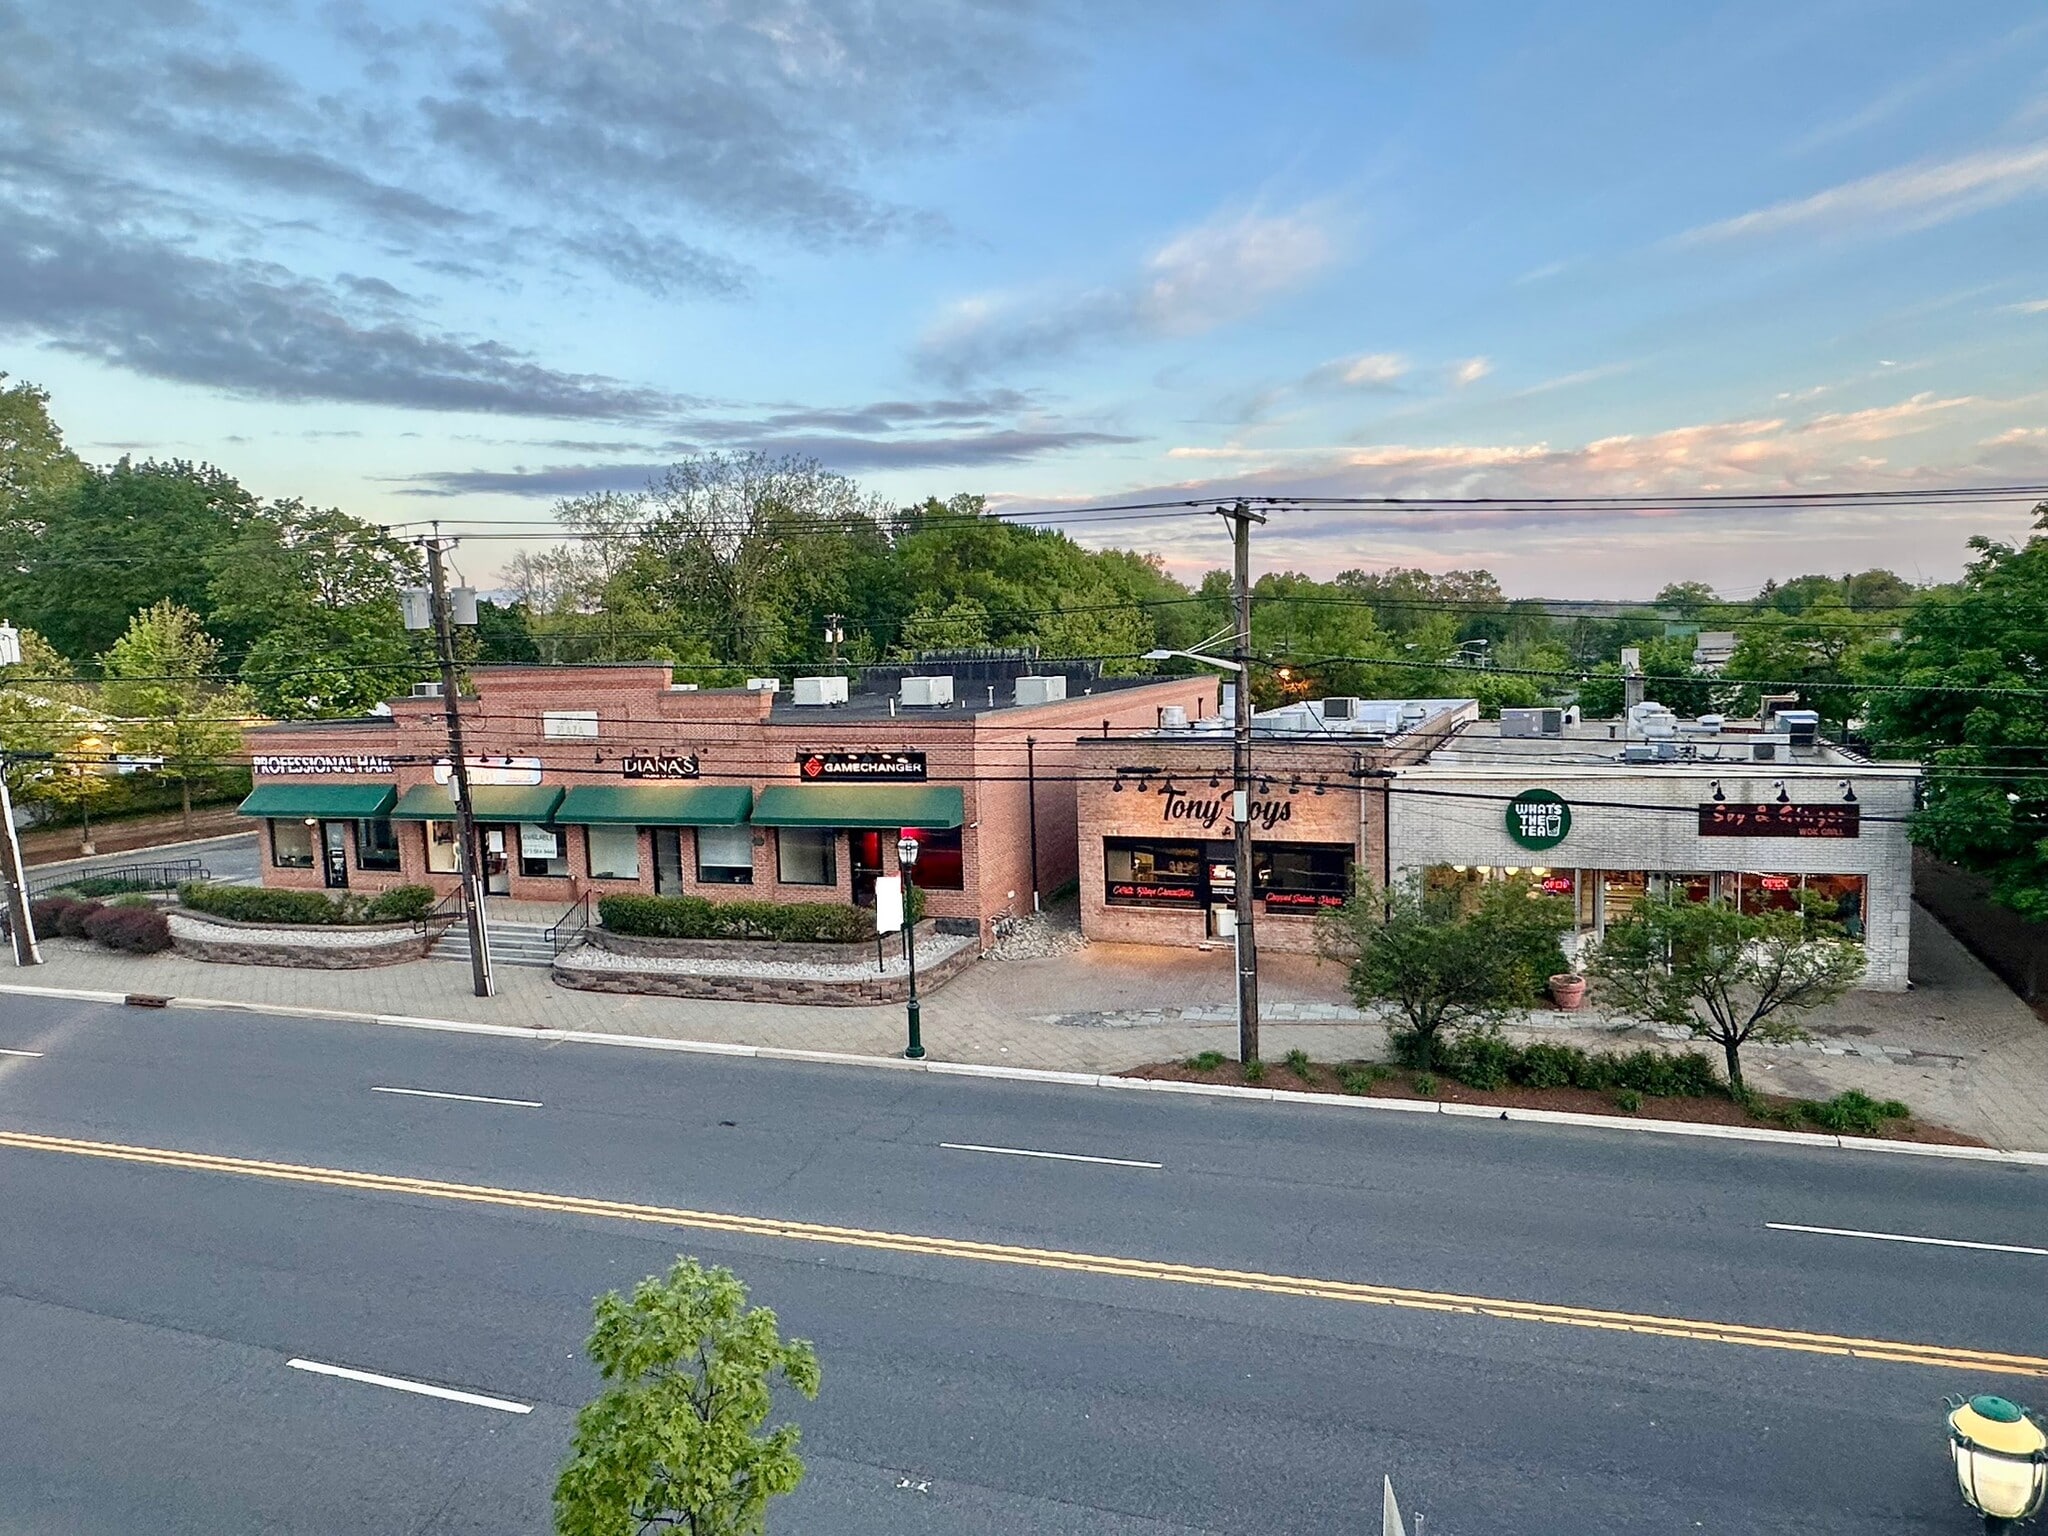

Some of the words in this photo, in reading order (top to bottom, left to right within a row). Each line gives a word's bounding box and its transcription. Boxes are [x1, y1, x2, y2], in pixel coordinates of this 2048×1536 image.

[252, 755, 355, 775] PROFESSIONAL
[357, 755, 393, 774] HAIR
[624, 757, 698, 774] DIANA'S
[824, 762, 922, 773] GAMECHANGER
[1157, 787, 1223, 829] Tony
[1221, 789, 1291, 830] oys
[1515, 803, 1563, 815] WHAT'S
[1519, 815, 1546, 826] THE
[1519, 826, 1546, 837] TEA
[1761, 878, 1789, 889] OPEN
